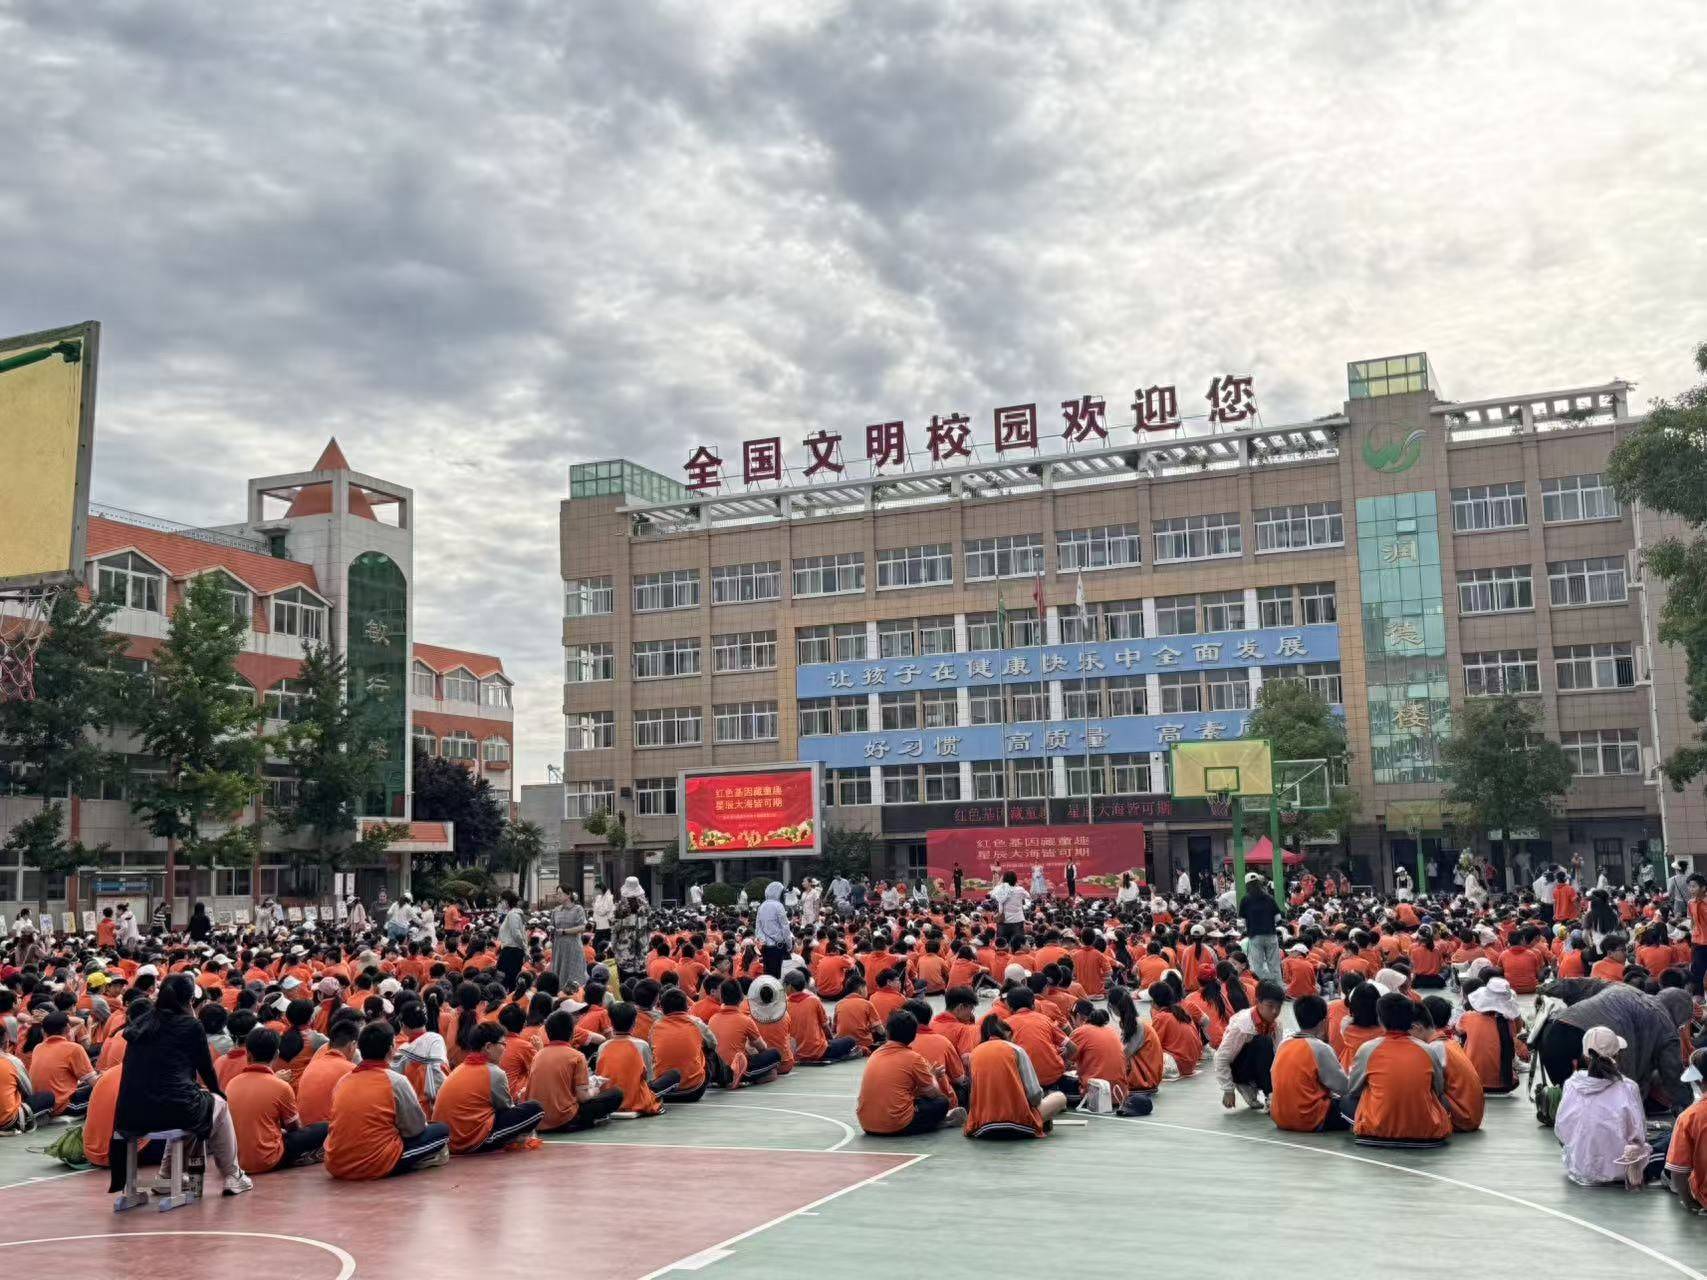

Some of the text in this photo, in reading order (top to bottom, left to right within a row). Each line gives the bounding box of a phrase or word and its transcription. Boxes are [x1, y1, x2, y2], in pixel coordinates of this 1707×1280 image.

[683, 374, 1256, 491] 全国文明校园欢迎您
[827, 637, 1310, 690] 让孩子在健康快乐中全面发展
[864, 736, 962, 759] 好习惯
[1005, 727, 1110, 754] 高质量
[715, 798, 783, 811] 星辰大海皆可期
[976, 848, 1090, 860] 星辰大海皆可期
